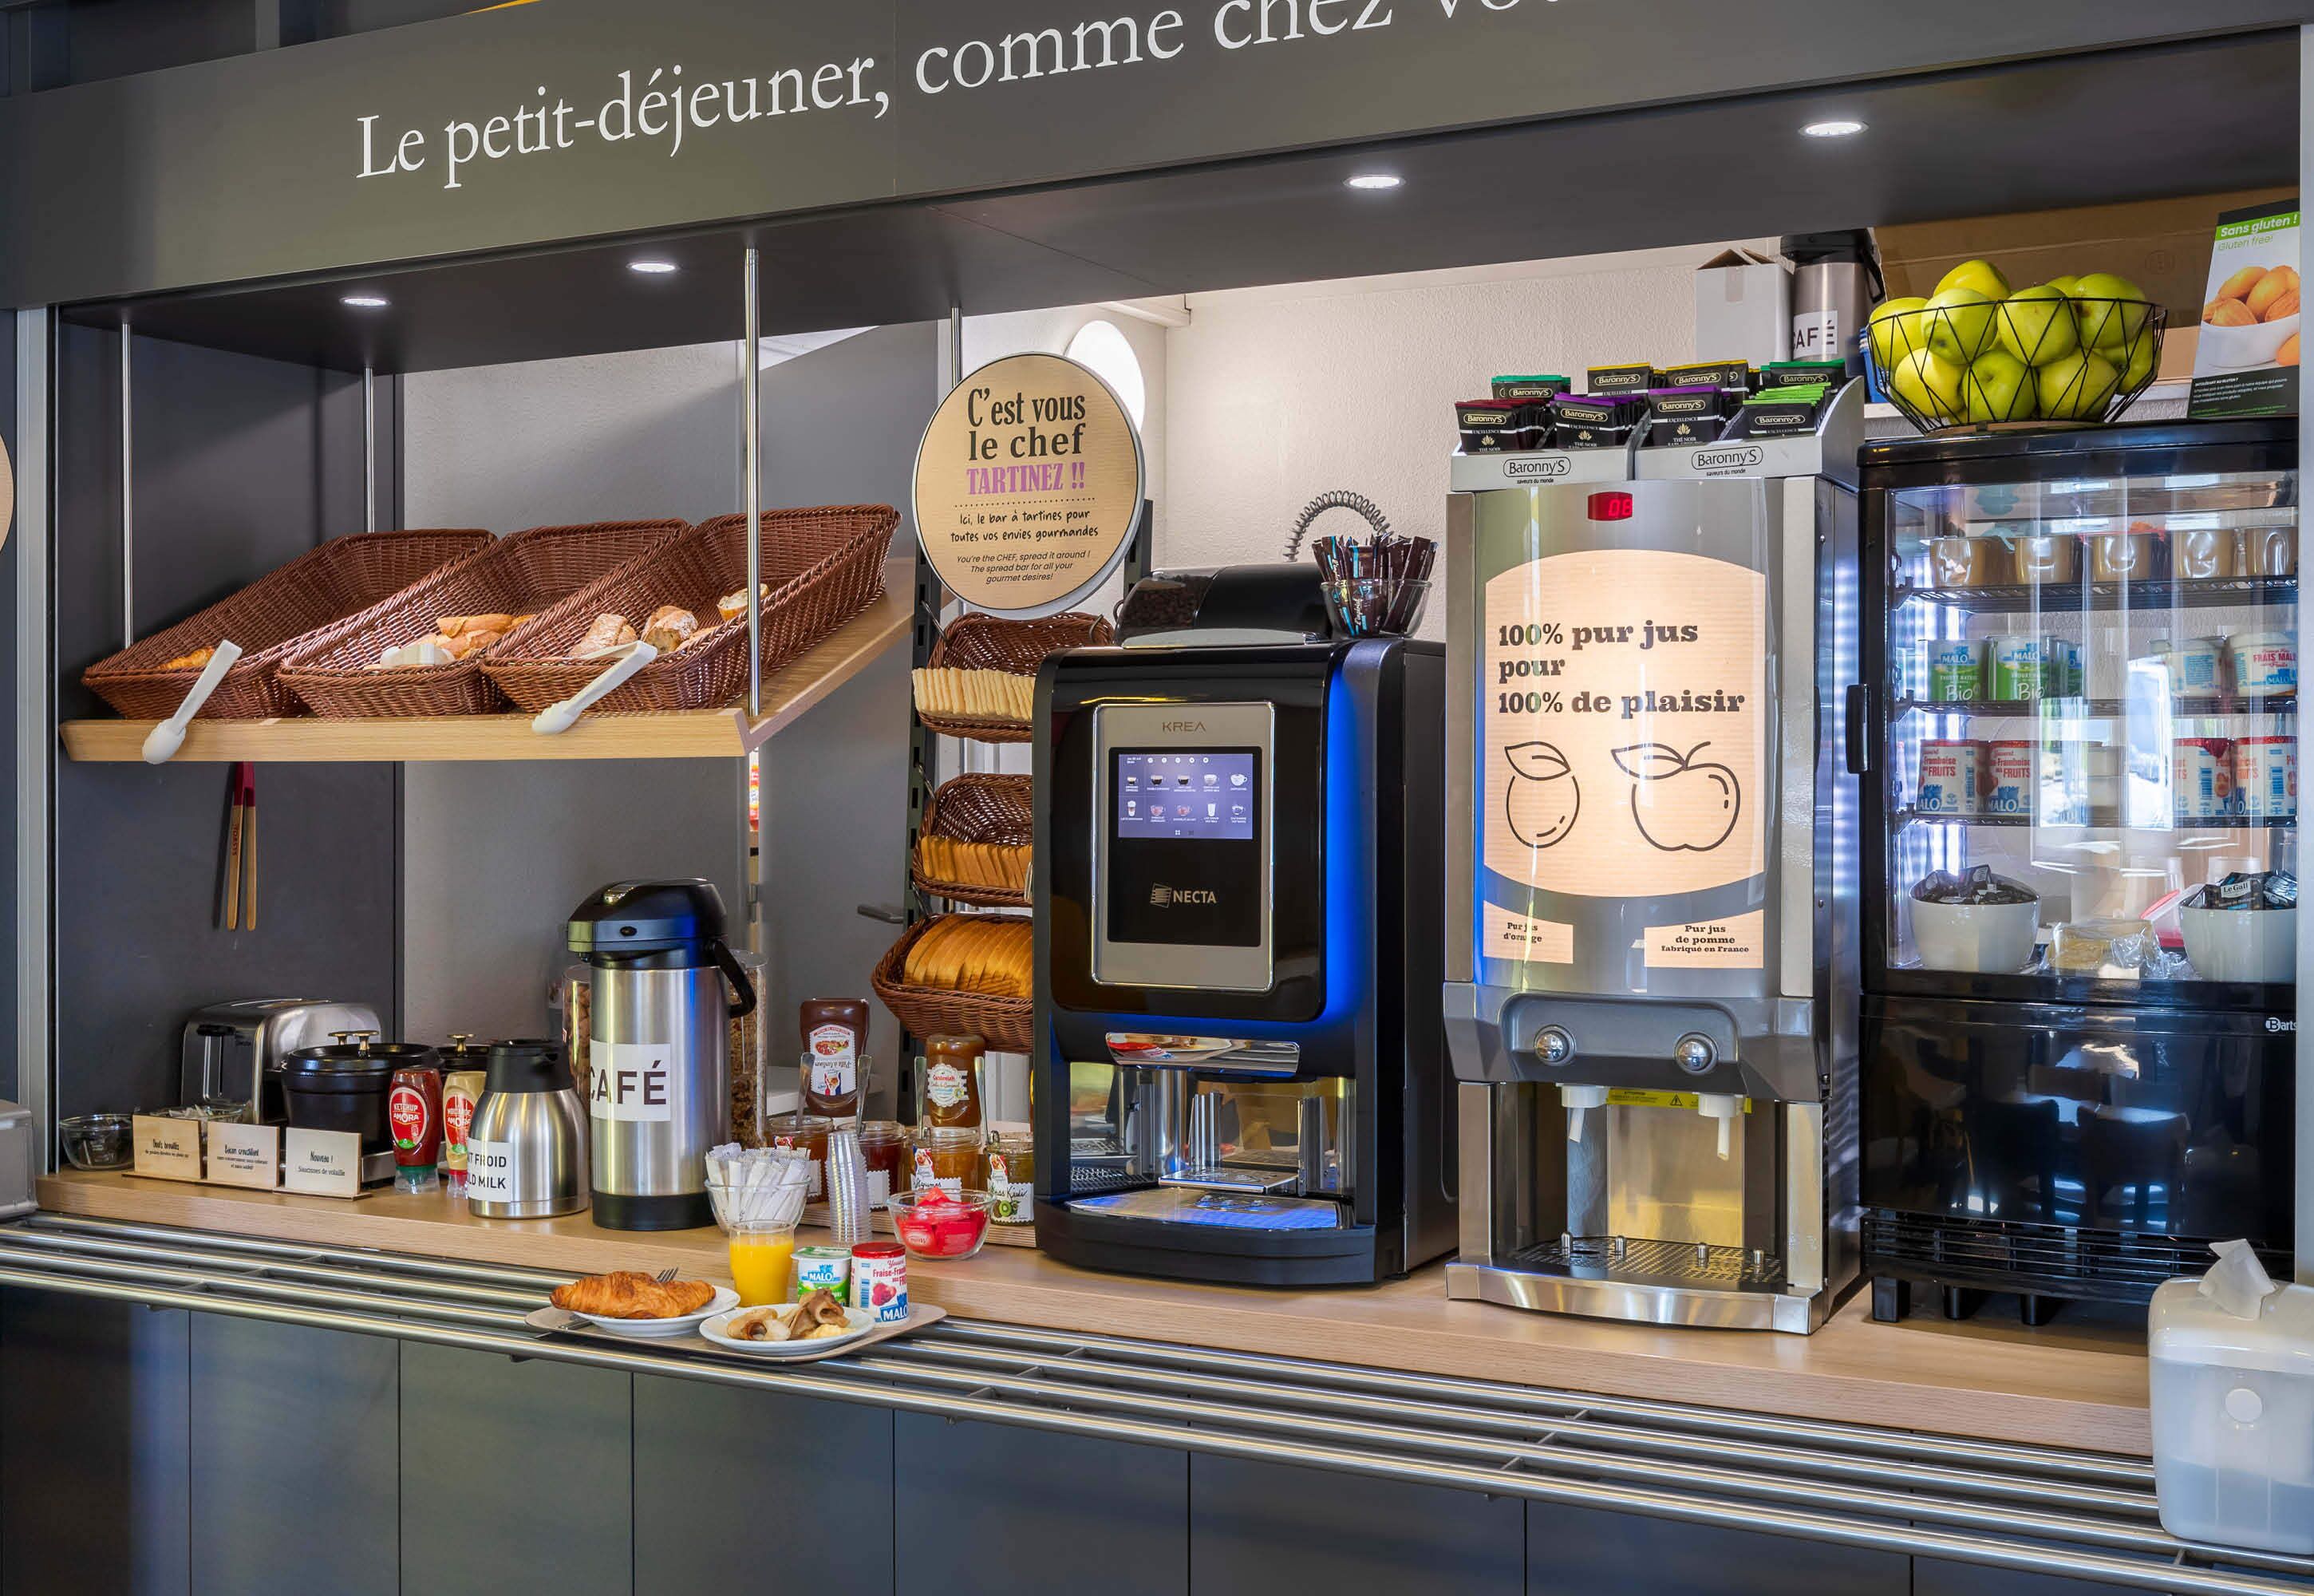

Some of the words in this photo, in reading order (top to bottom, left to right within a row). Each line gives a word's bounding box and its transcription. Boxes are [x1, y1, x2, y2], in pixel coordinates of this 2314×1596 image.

[356, 115, 424, 179] Le
[444, 57, 889, 189] petit-déjeuner,
[915, 10, 1184, 94] comme
[2221, 224, 2249, 237] Sans
[2252, 216, 2290, 234] gluten
[2293, 214, 2298, 223] !
[1792, 321, 1835, 350] AFÉ
[967, 388, 1025, 427] C'est
[1032, 395, 1086, 422] vous
[969, 431, 998, 460] le
[1010, 423, 1086, 458] chef
[966, 462, 1064, 496] TARTINEZ
[1072, 462, 1085, 489] !!
[960, 515, 973, 526] Ici,
[977, 513, 985, 524] le
[989, 513, 1007, 523] bar
[1012, 509, 1019, 522] à
[1022, 510, 1062, 522] tartines
[1066, 510, 1091, 524] pour
[951, 531, 979, 543] toutes
[983, 532, 998, 542] vos
[1002, 528, 1032, 540] envies
[1036, 526, 1099, 543] gourmandes
[957, 554, 981, 563] You're
[983, 554, 995, 563] the
[1020, 551, 1047, 563] spread
[1056, 550, 1086, 559] around
[971, 564, 985, 573] The
[986, 563, 1014, 575] spread
[1016, 563, 1029, 572] bar
[1032, 563, 1042, 571] for
[1055, 562, 1073, 572] your
[986, 574, 1021, 584] gourmet
[1022, 573, 1053, 582] desires!
[1499, 623, 1564, 646] 100%
[1572, 625, 1634, 650] pur
[1640, 620, 1699, 650] jus
[1942, 654, 1968, 663] MALO
[1499, 658, 1566, 684] pour
[1945, 685, 1973, 701] Bio
[1499, 692, 1563, 713] 100%
[1572, 691, 1612, 713] de
[1621, 689, 1746, 719] plaisir
[1162, 721, 1206, 733] KREA
[1928, 766, 1956, 776] FRUITS
[1173, 890, 1217, 904] NECTA
[1506, 922, 1523, 930] Pur
[1524, 922, 1538, 933] js
[1708, 925, 1726, 934] jus
[1503, 932, 1542, 944] d'orage
[393, 1103, 419, 1112] KETCHUP
[475, 1153, 507, 1167] FROID
[478, 1175, 507, 1190] MILK
[809, 1272, 833, 1281] MALO
[883, 1306, 909, 1321] MALO
